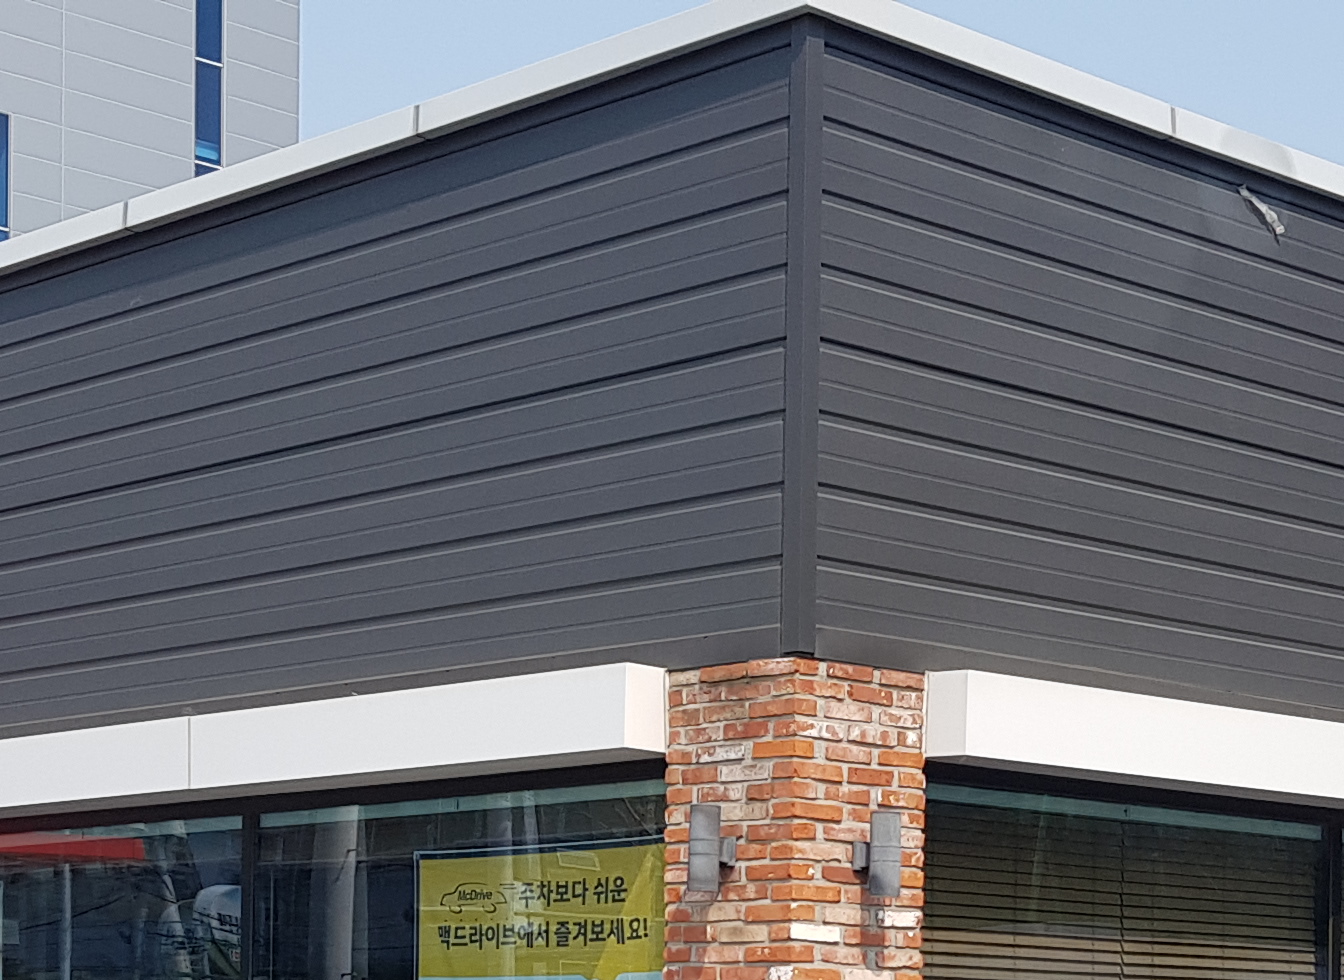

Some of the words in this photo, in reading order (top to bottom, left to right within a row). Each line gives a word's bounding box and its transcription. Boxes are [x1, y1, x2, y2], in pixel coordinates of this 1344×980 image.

[457, 888, 493, 901] McDrive
[519, 878, 588, 908] 주차보다
[593, 876, 628, 905] 쉬운
[438, 920, 549, 950] 맥드라이브에서
[554, 917, 649, 946] 즐겨보세요!
